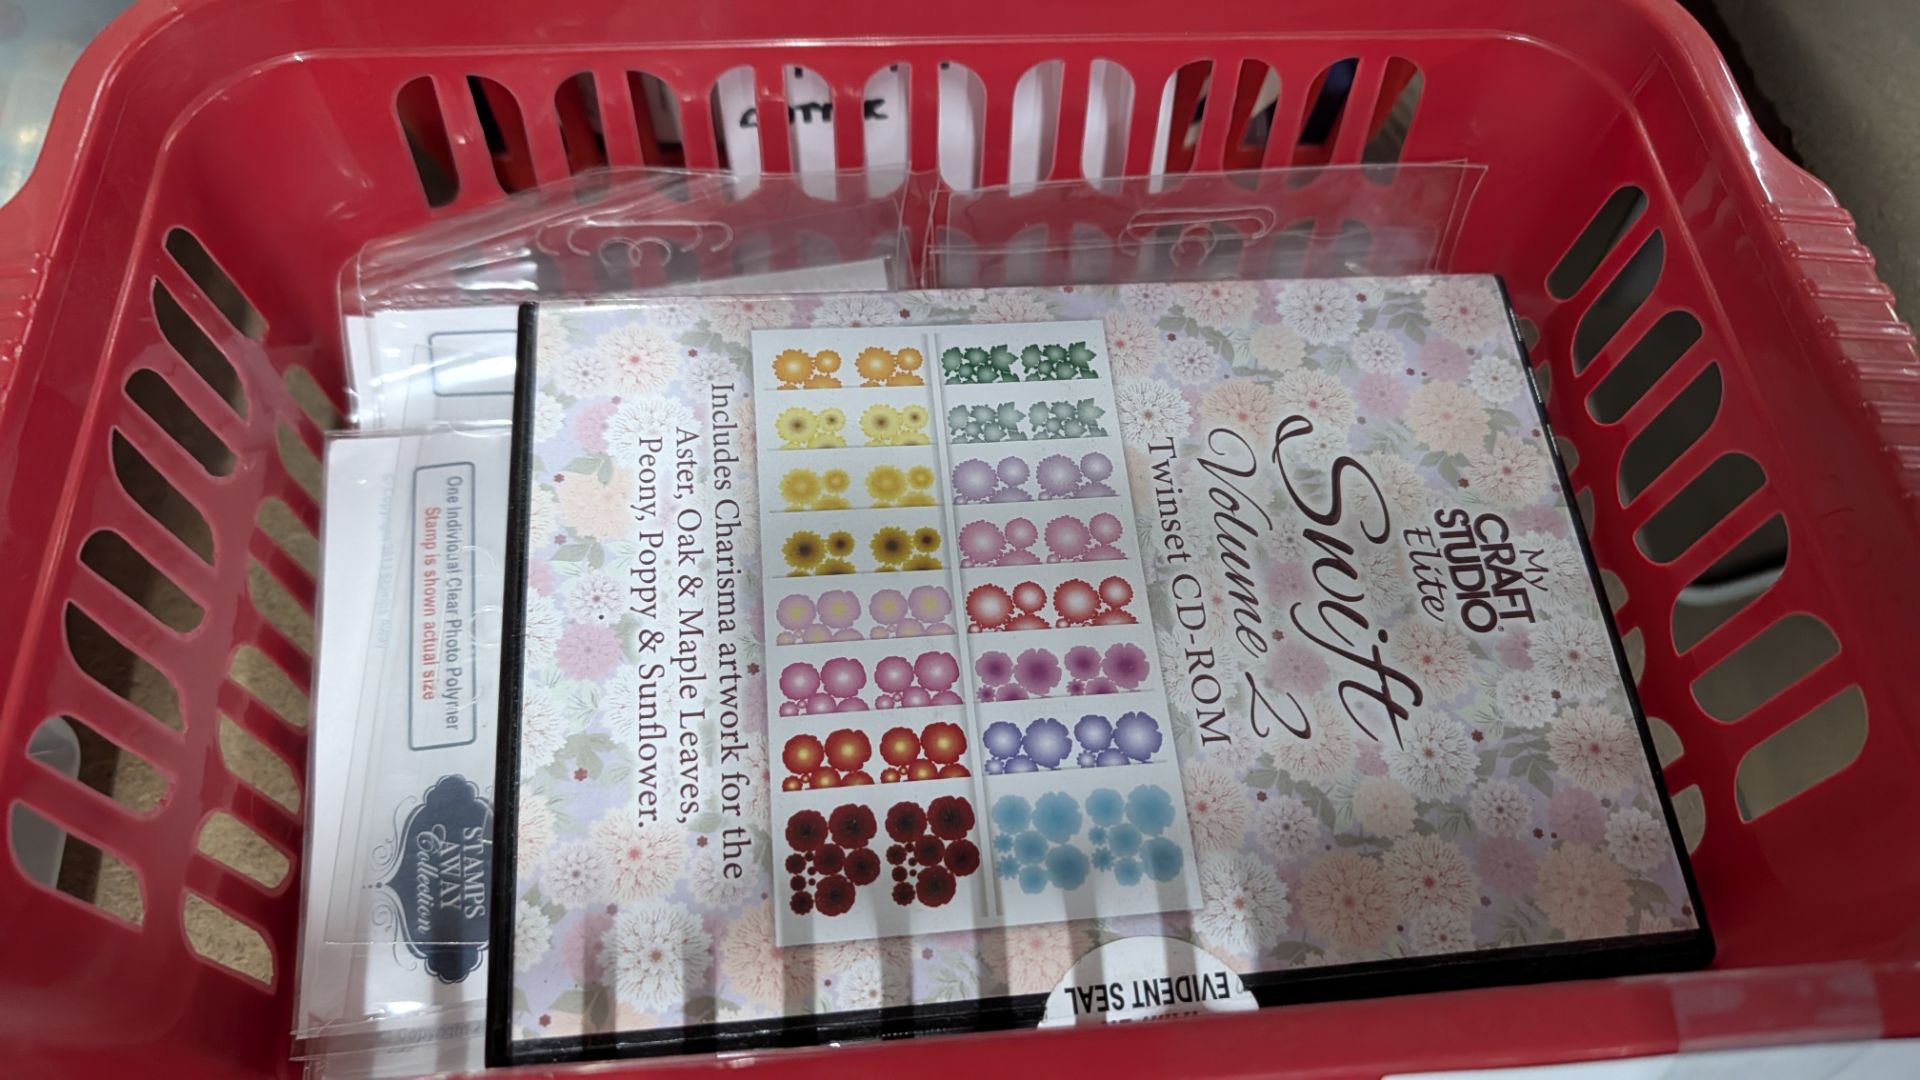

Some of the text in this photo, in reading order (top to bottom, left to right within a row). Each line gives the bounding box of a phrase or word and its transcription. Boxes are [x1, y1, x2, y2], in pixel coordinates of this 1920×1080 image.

[446, 475, 463, 503] One
[420, 506, 441, 700] Stamp is shown actual size
[445, 577, 463, 615] Clear
[1147, 436, 1232, 747] Twinset CD-ROM
[1196, 427, 1312, 740] Volume 2
[1271, 414, 1424, 751] Swift
[1402, 525, 1448, 623] Elite
[1433, 508, 1498, 633] STUDIO
[1473, 512, 1537, 624] CRAFT
[1518, 548, 1549, 592] My
[445, 619, 463, 663] Photo
[630, 436, 668, 828] Peony, Poppy & Sunflower.
[670, 426, 708, 824] Aster, Oak & Maple Leaves,
[711, 383, 752, 880] Includes Charisma artwork for the
[441, 667, 463, 730] Polymer
[416, 823, 446, 934] Collection
[440, 841, 461, 909] AWAY
[463, 826, 486, 919] STAMPS
[1064, 972, 1230, 1015] EVIDENT SEAL
